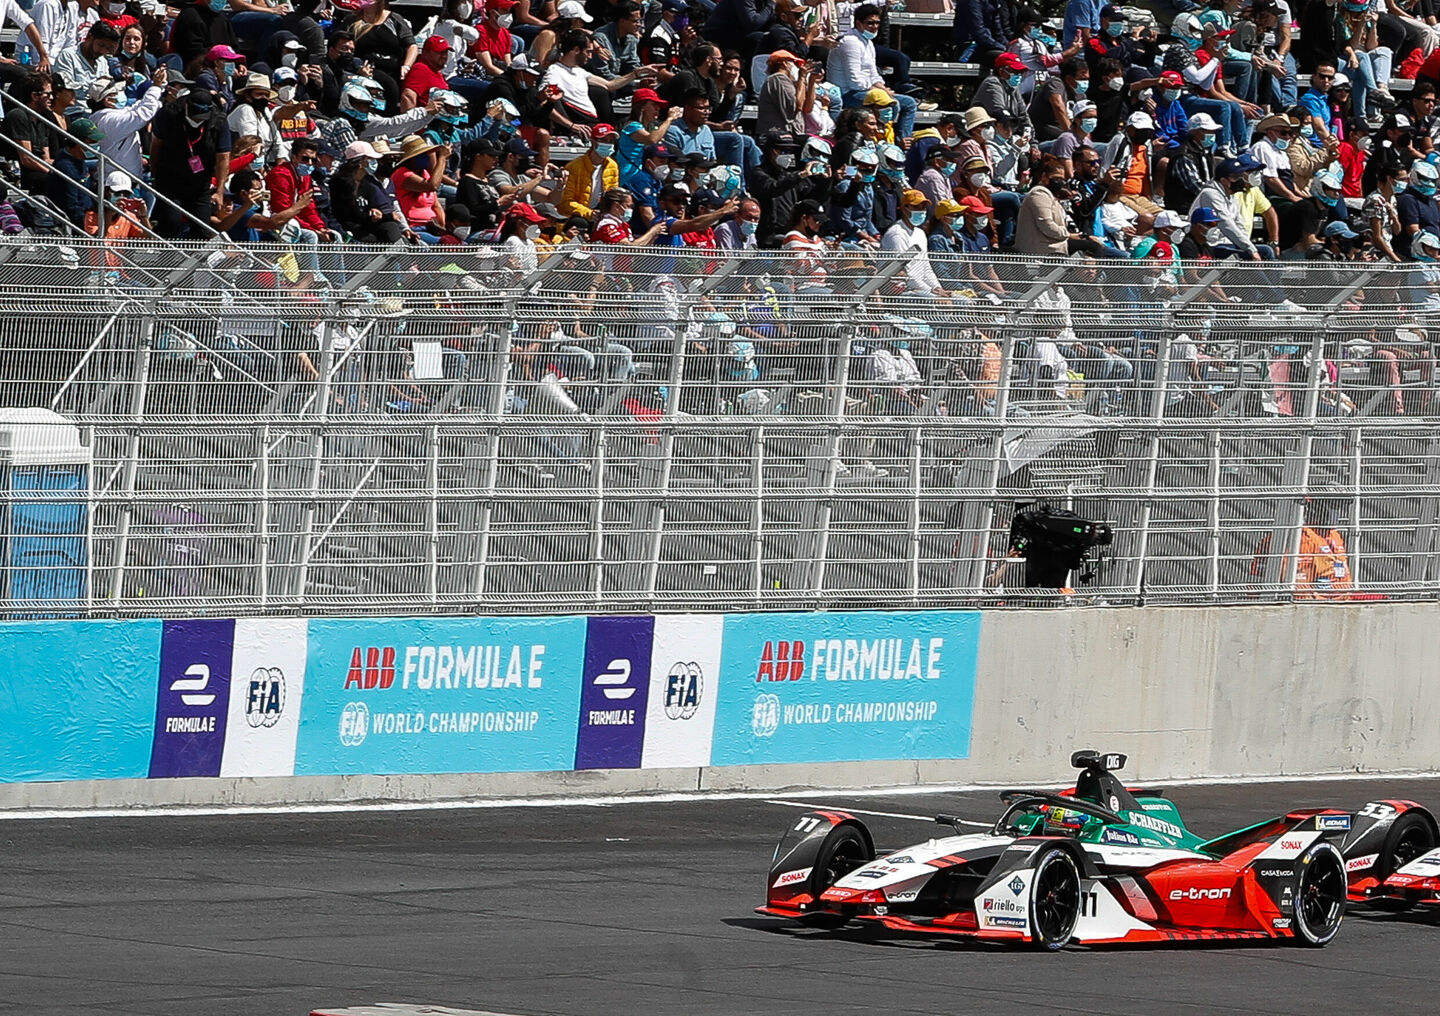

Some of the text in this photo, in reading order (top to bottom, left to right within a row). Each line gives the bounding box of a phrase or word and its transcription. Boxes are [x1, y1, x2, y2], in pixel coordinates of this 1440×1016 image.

[344, 645, 545, 690] ABB FORMULA E
[756, 637, 944, 682] ABB FORMULA E
[246, 680, 280, 715] FIA
[665, 674, 697, 708] FIA
[589, 709, 636, 726] FORMULA E
[783, 704, 831, 724] WORLD
[836, 701, 938, 723] CHAMPIONSHIP
[165, 717, 216, 733] FORMULA E
[372, 713, 425, 735] WORLD
[429, 711, 539, 734] CHAMPIONSHIP
[1106, 755, 1120, 769] DIG
[1358, 802, 1396, 820] 33
[794, 816, 821, 833] 11
[1128, 811, 1183, 839] SCHAEFFLER
[1280, 840, 1302, 850] SONAX
[1348, 857, 1373, 869] SONAX
[781, 871, 806, 883] SONAX
[1169, 887, 1231, 900] e-tron
[994, 899, 1015, 912] riello
[1081, 892, 1098, 917] 11
